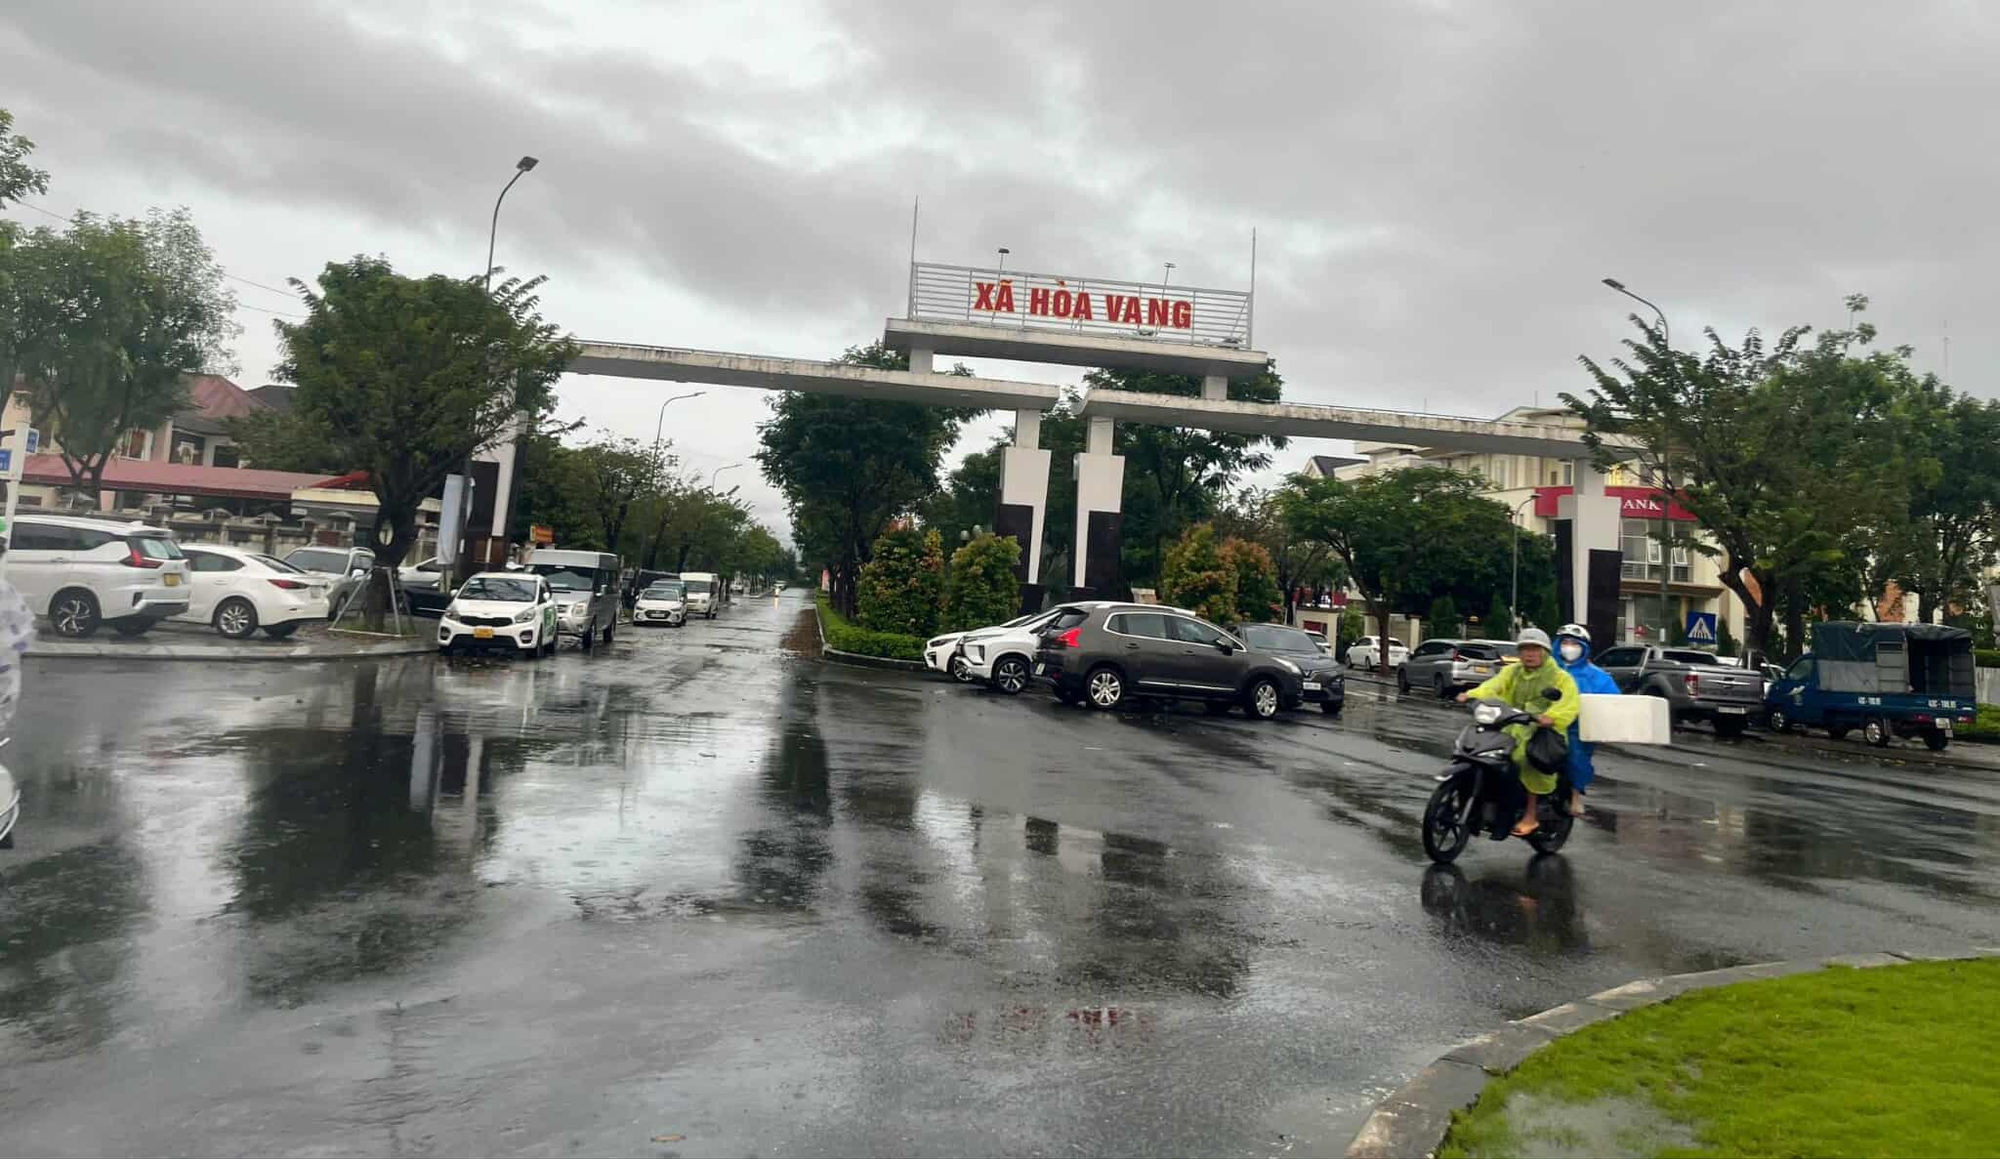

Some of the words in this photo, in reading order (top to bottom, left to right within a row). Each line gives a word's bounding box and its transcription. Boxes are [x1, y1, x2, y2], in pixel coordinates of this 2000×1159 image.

[974, 279, 1015, 313] XÃ
[1029, 280, 1093, 320] HÒA
[1105, 293, 1192, 329] VANG
